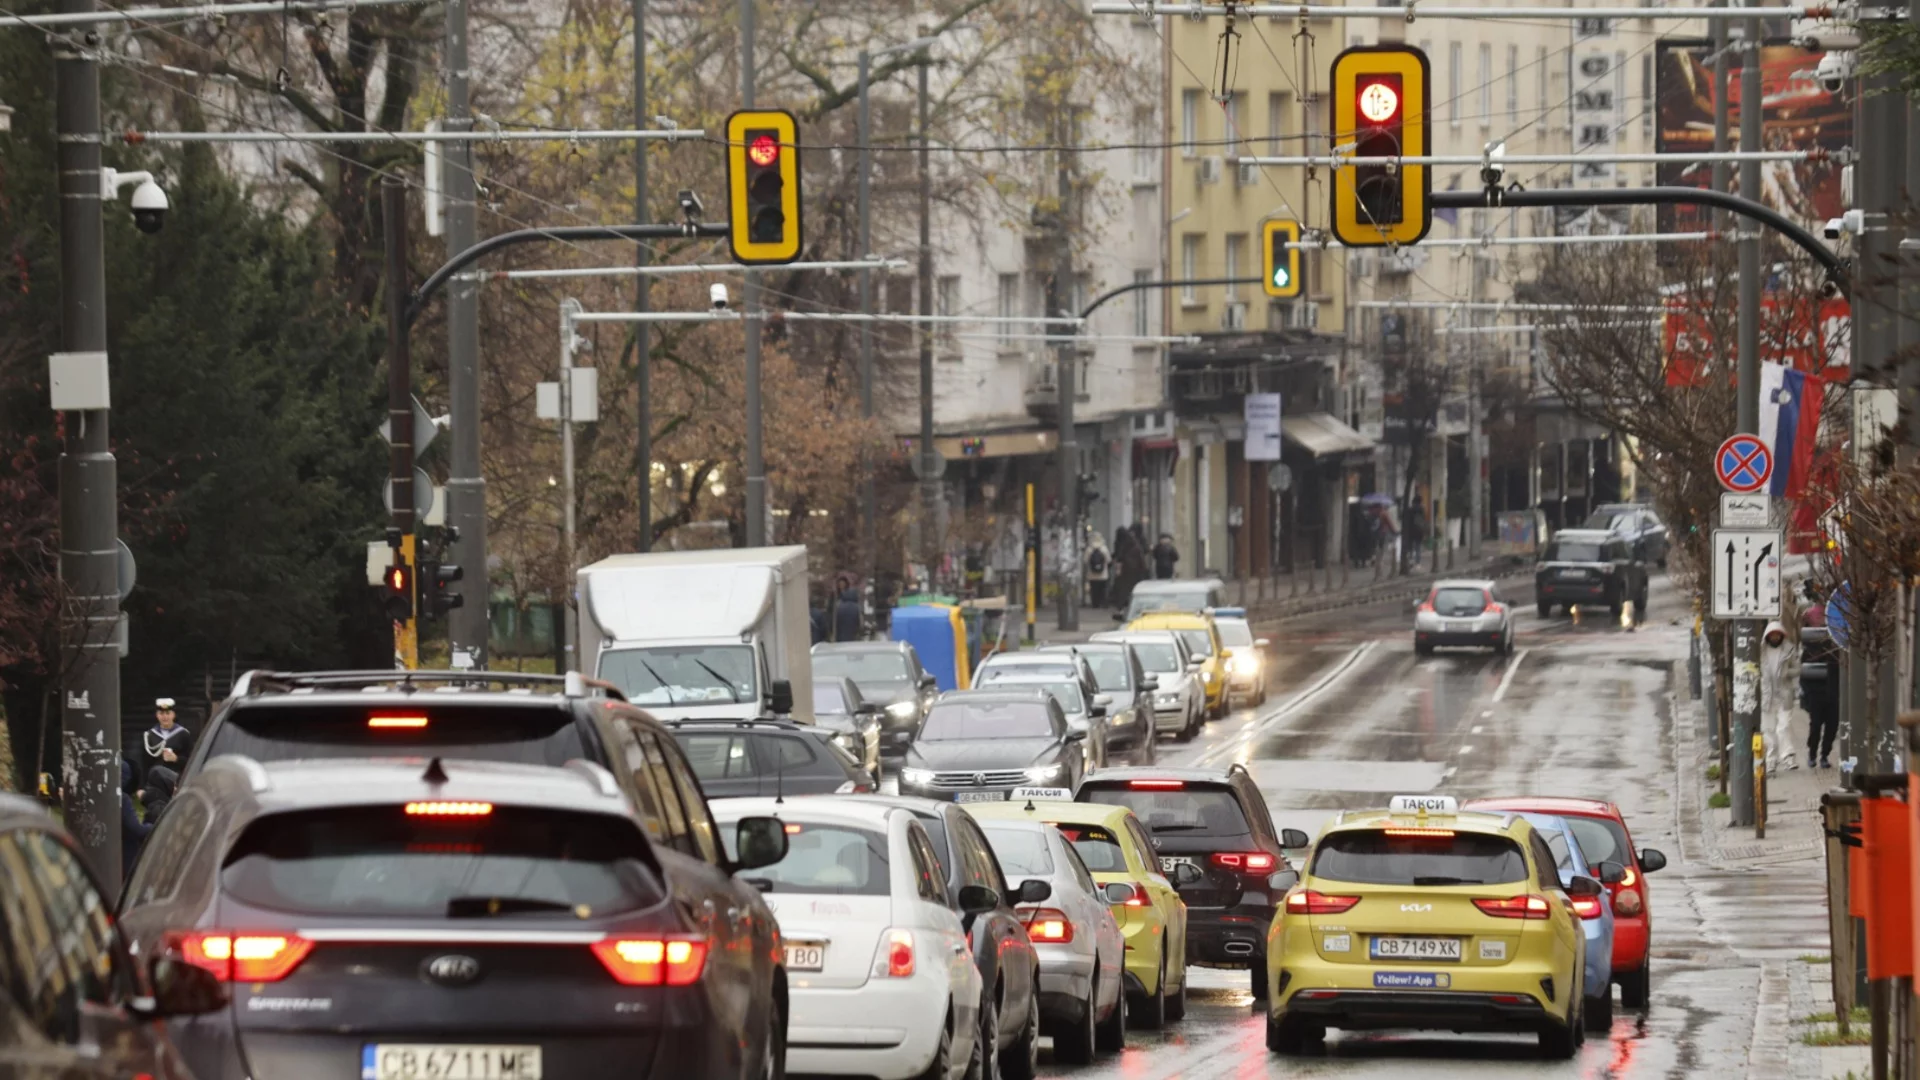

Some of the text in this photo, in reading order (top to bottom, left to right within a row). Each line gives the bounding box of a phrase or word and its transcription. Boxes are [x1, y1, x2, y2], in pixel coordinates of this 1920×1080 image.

[1020, 789, 1062, 797] ТАКСИ
[1402, 799, 1445, 810] ТАКСИ
[1379, 940, 1457, 955] CB 7149 XK
[1376, 974, 1433, 986] Yellow! App
[382, 1050, 536, 1080] CB 6711 ME
